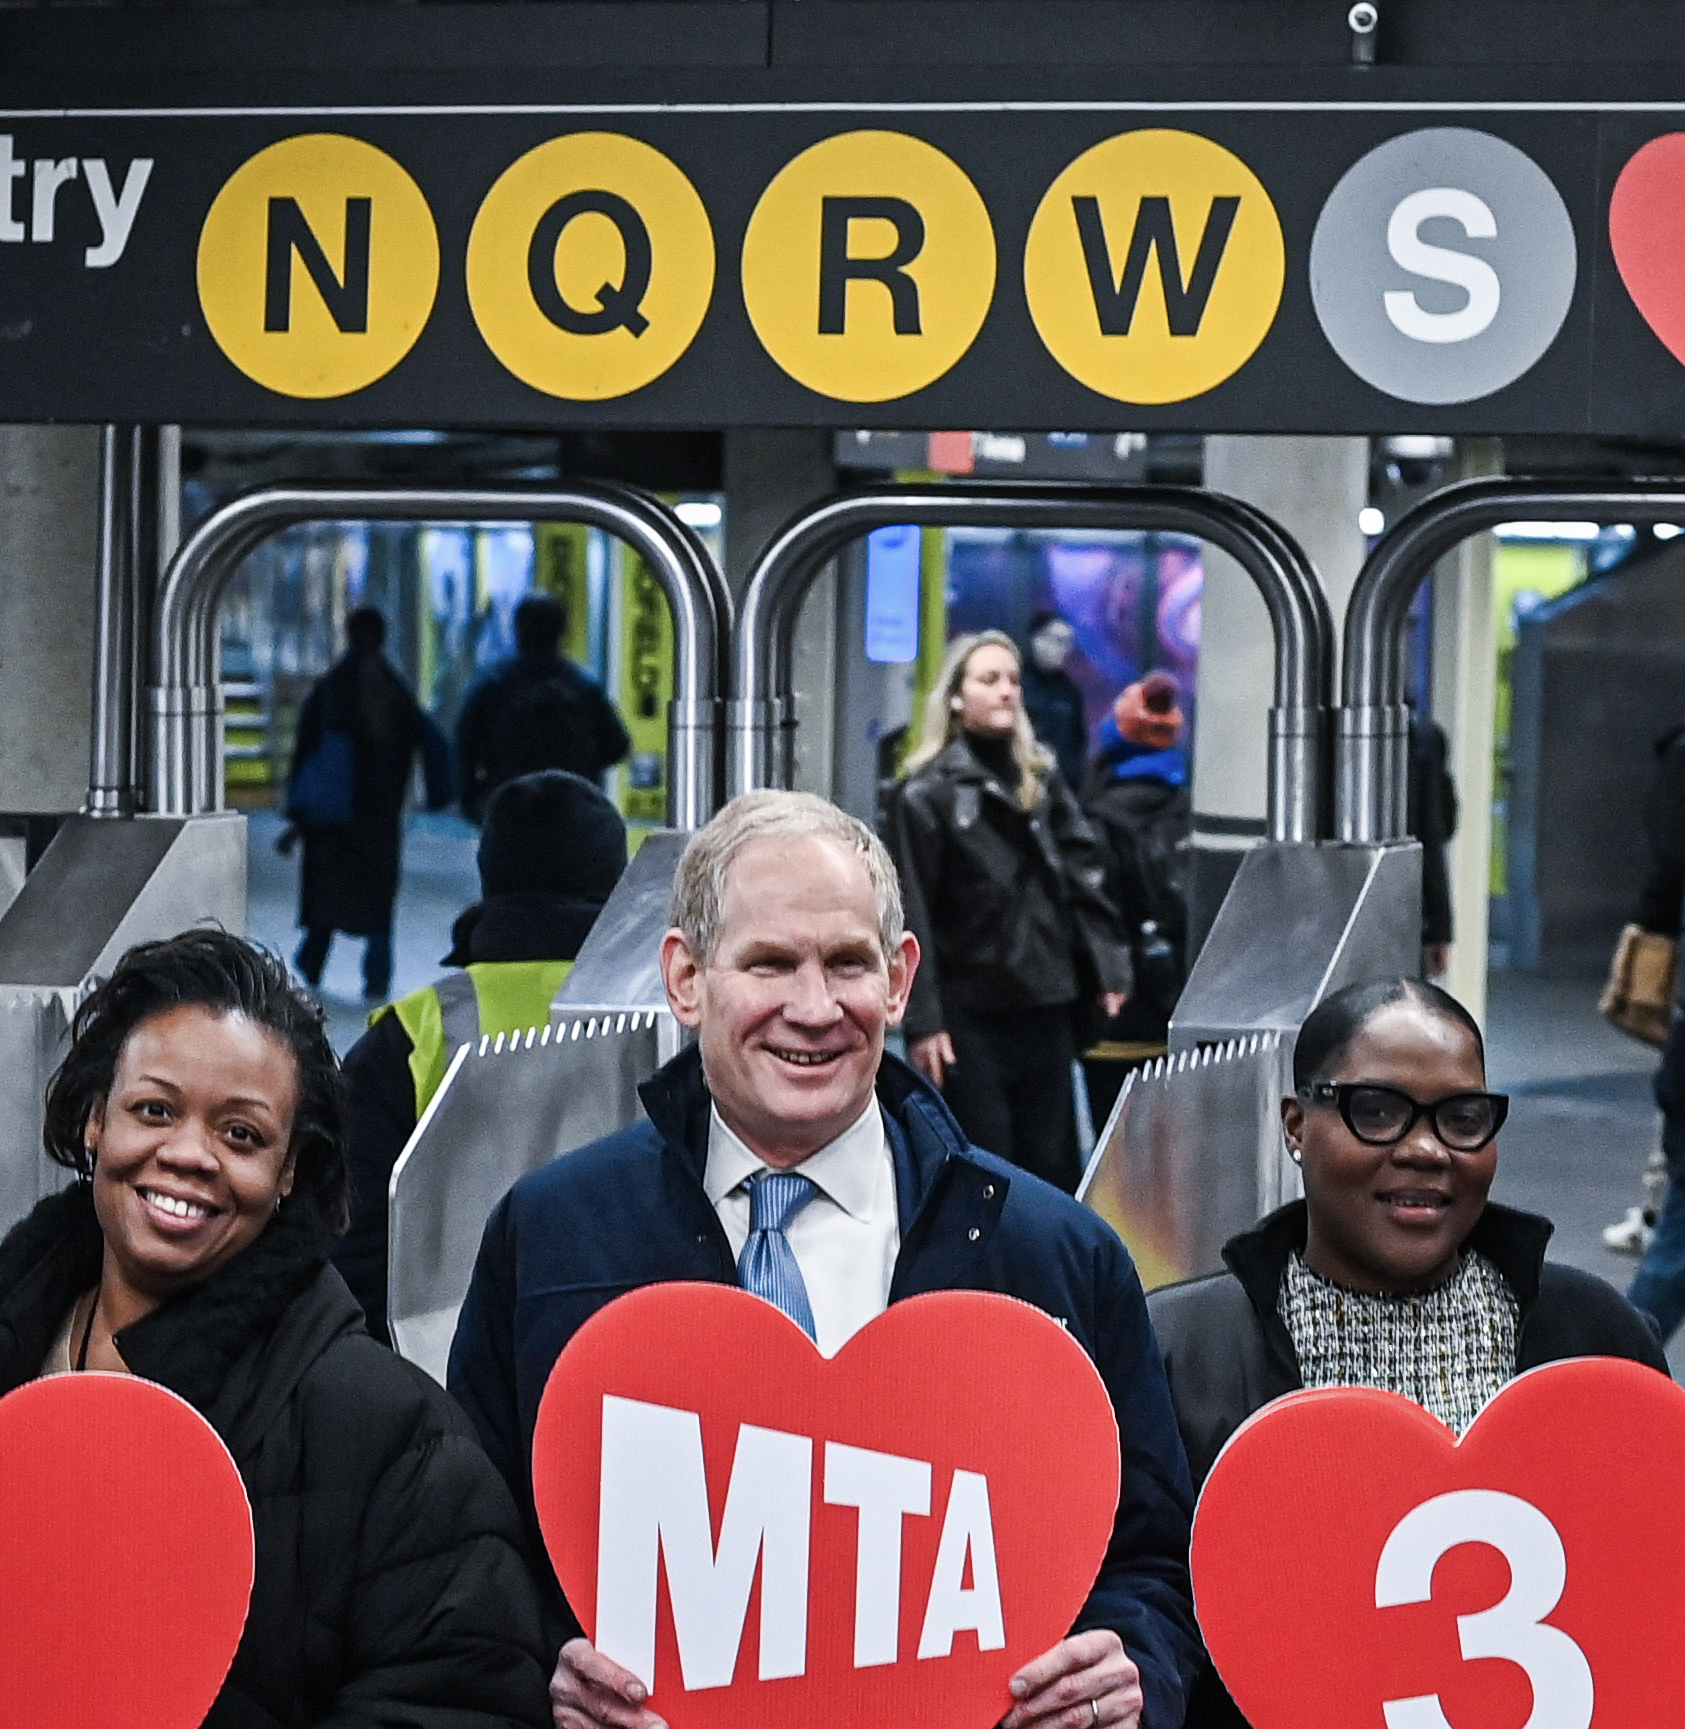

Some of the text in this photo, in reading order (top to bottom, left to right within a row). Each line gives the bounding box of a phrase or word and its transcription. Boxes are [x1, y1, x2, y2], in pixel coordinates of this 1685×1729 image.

[263, 196, 373, 335] N
[527, 188, 653, 339] Q
[817, 195, 926, 336] R
[1070, 195, 1242, 337] W
[1383, 188, 1500, 343] S
[595, 1394, 1007, 1697] MTA
